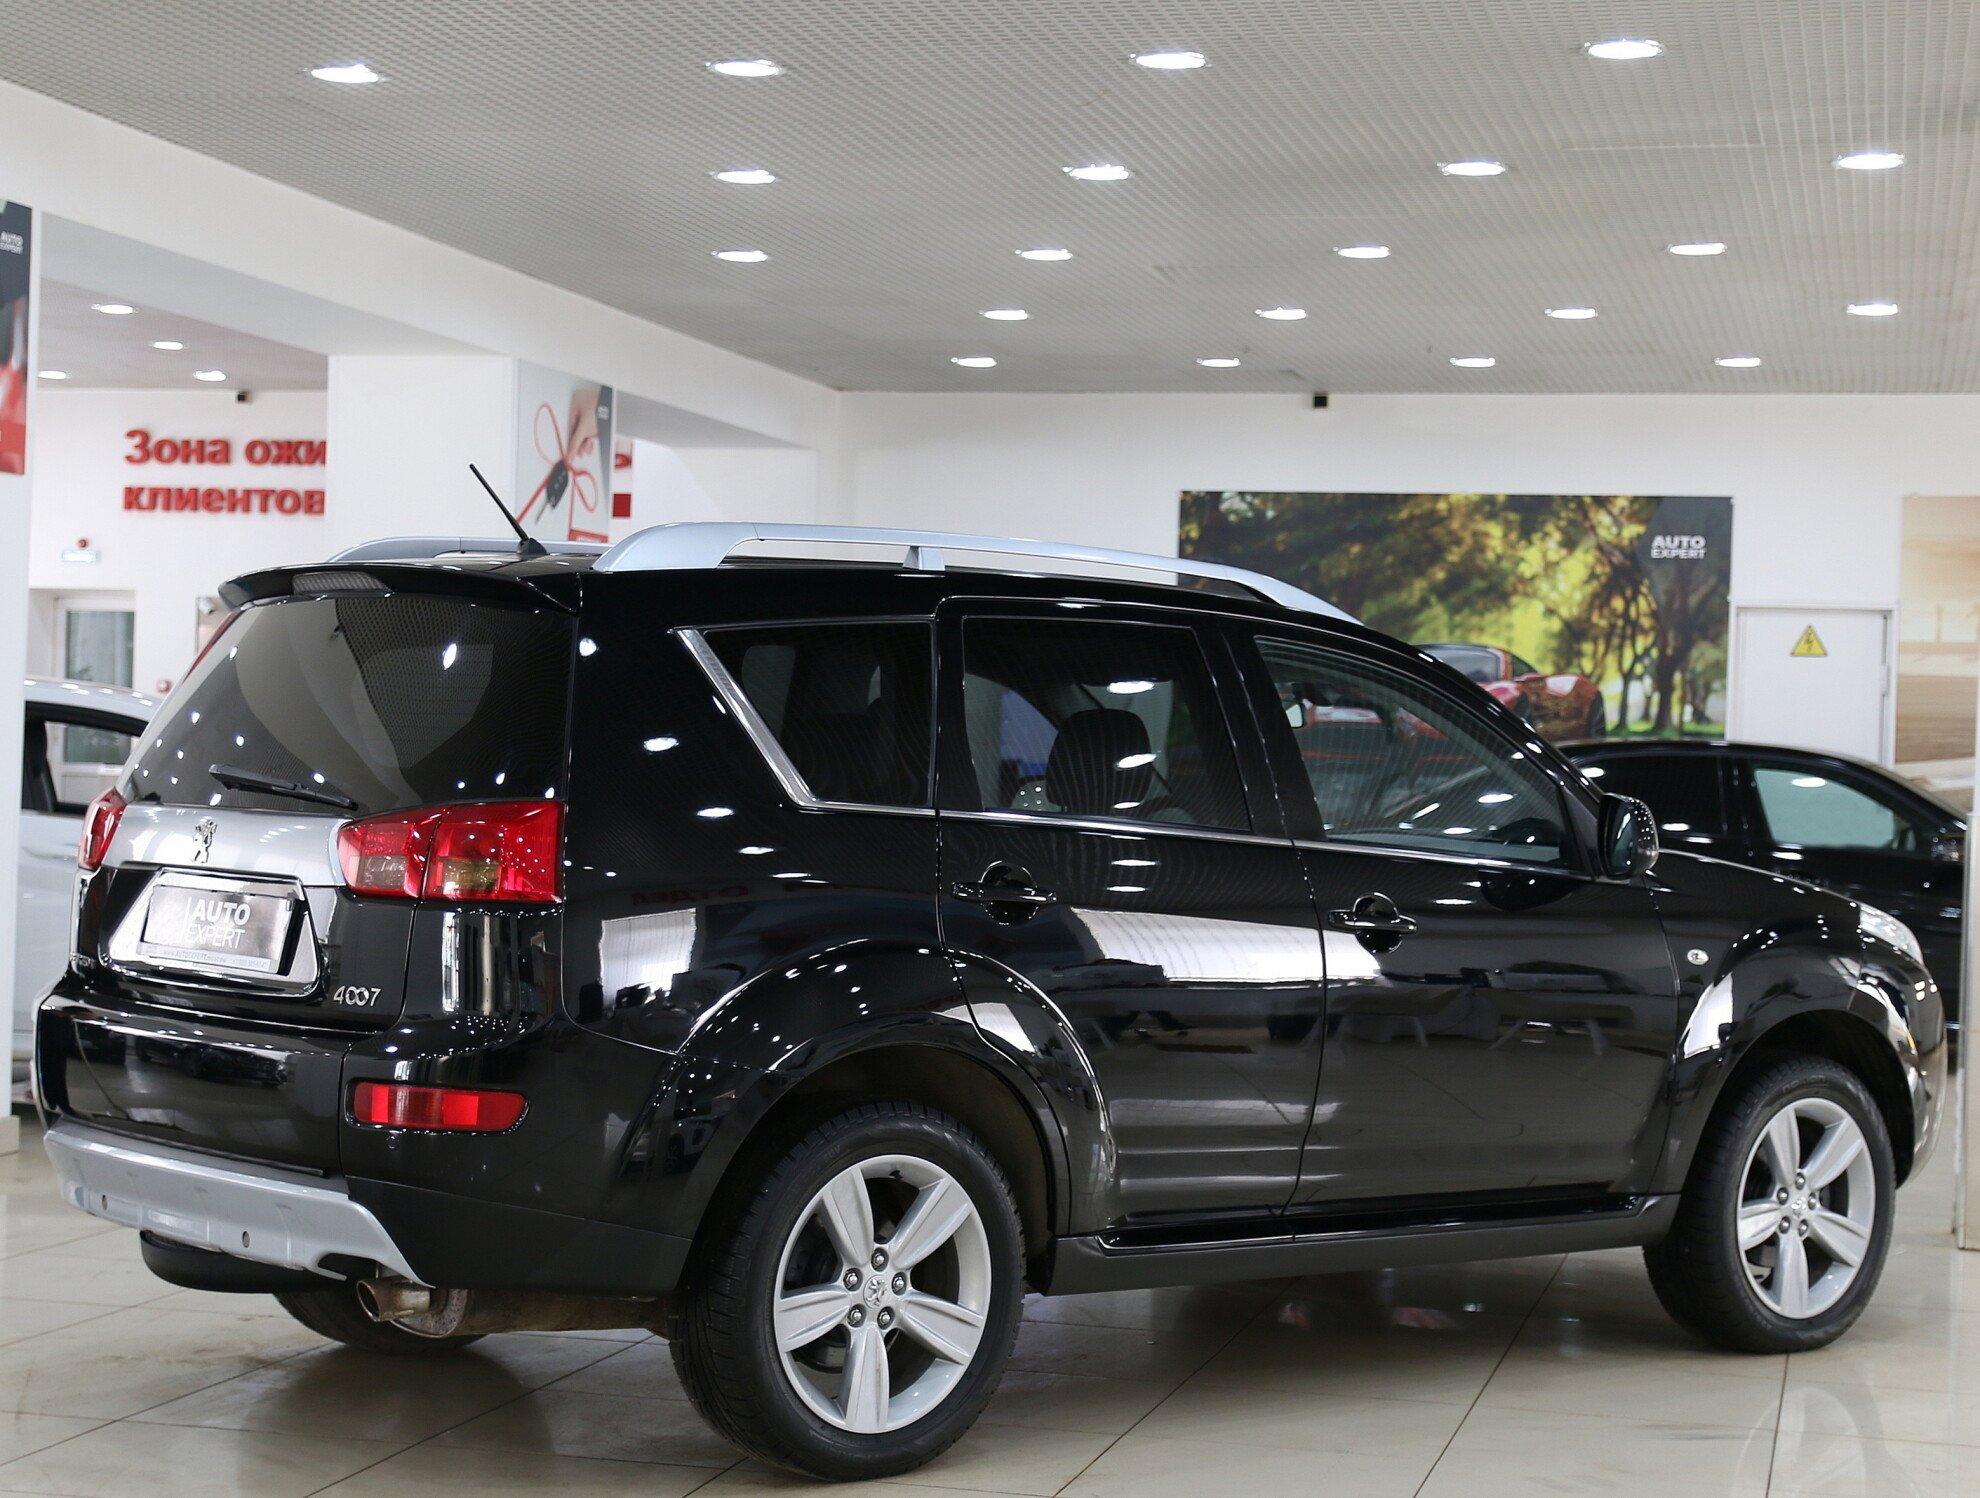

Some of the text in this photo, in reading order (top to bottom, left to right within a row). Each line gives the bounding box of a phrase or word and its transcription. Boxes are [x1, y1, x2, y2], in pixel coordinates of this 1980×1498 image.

[125, 428, 230, 465] Зона
[123, 486, 325, 515] клиентов
[1651, 534, 1706, 549] AUTO
[1651, 548, 1706, 559] EXPERT
[191, 898, 251, 926] AUTO
[186, 923, 246, 949] EXPERT
[333, 985, 381, 1007] 4007
